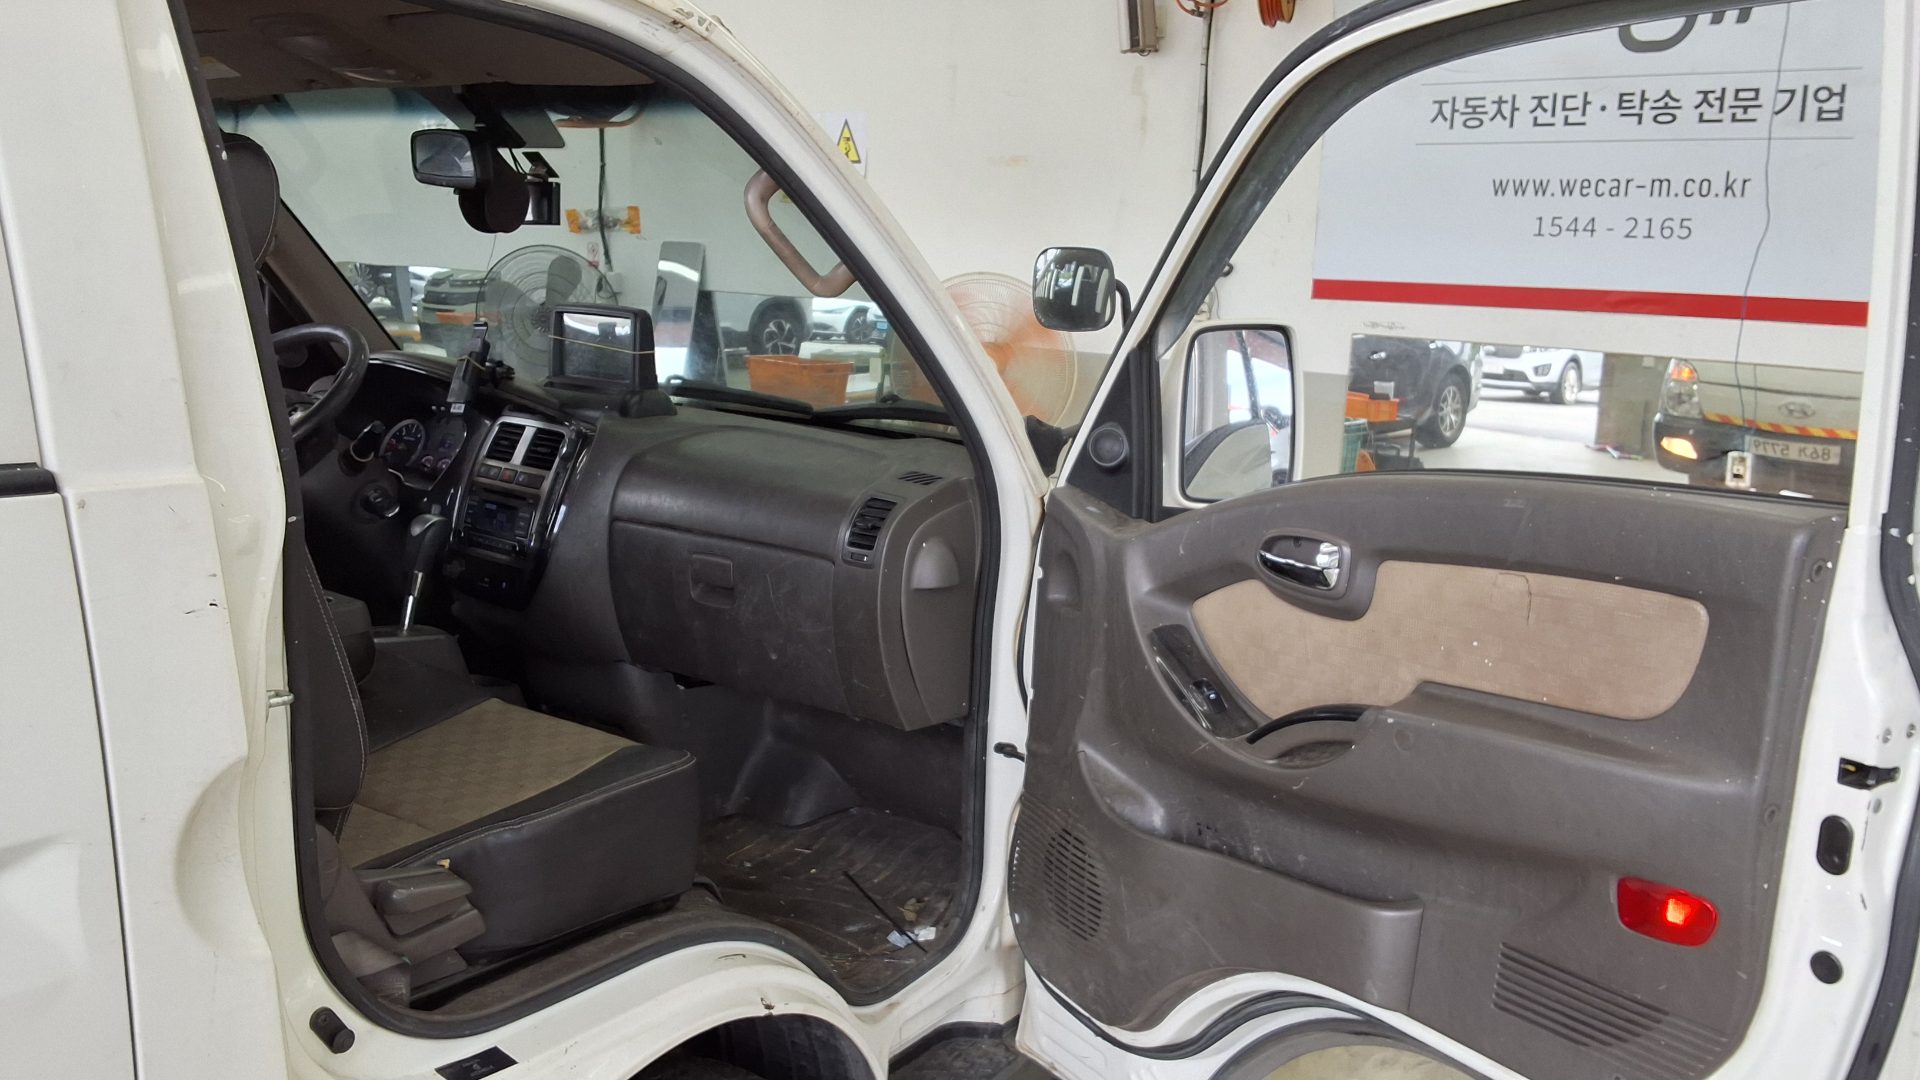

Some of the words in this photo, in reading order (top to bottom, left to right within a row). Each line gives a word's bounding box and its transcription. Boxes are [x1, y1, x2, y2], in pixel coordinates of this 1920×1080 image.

[1431, 94, 1520, 130] 자동차
[1694, 87, 1763, 123] 전문
[1773, 84, 1847, 122] 기업
[1492, 170, 1752, 198] www.wecar-m.co.kr
